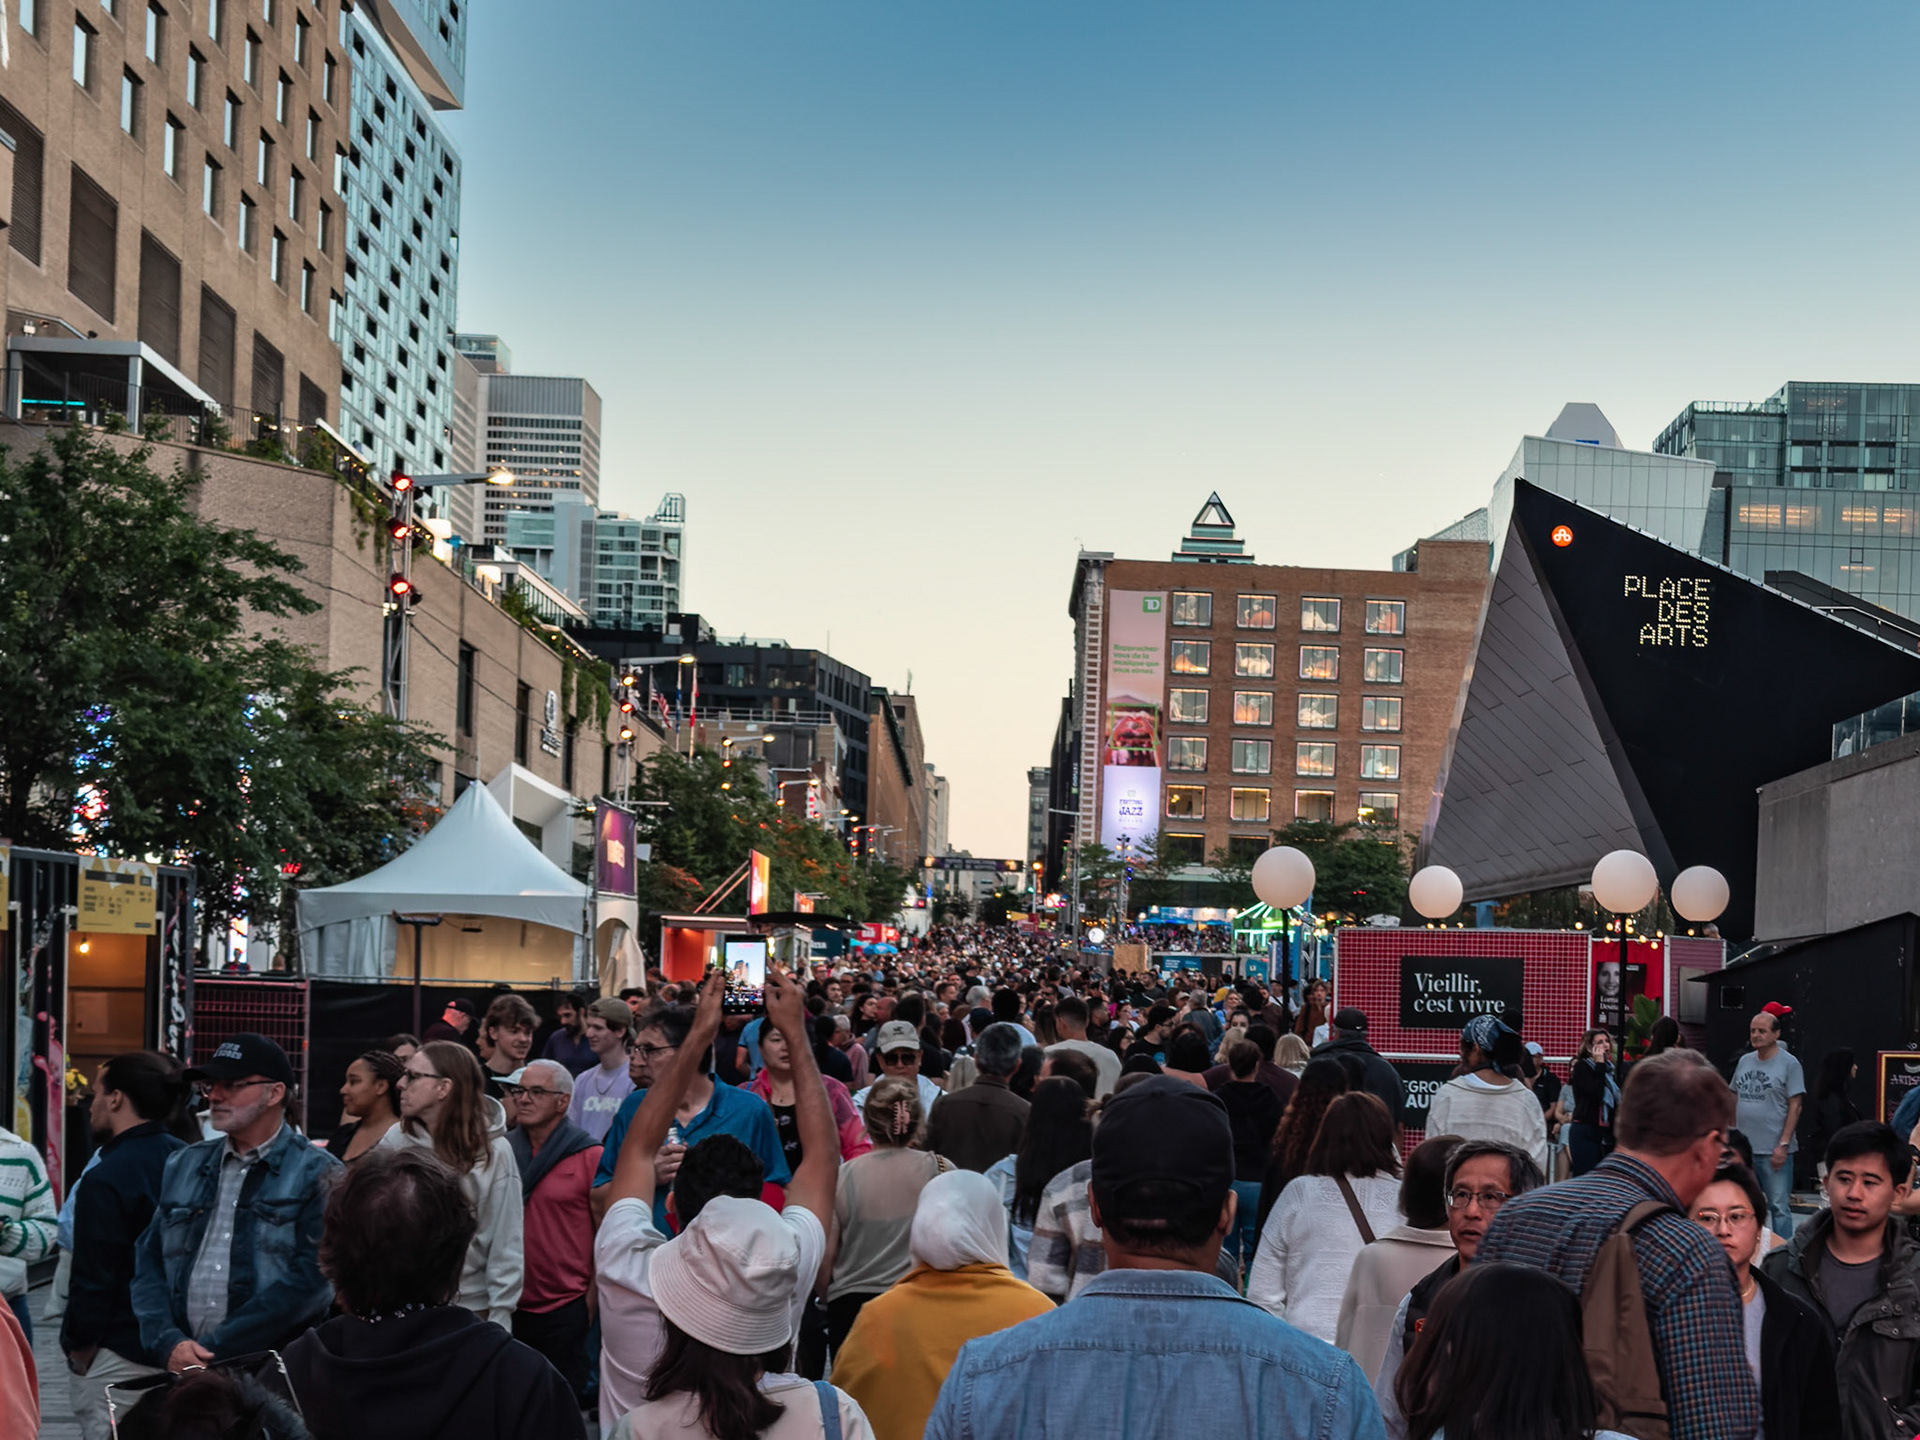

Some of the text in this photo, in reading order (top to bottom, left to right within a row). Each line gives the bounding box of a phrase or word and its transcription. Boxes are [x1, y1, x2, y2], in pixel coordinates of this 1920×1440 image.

[1624, 575, 1711, 600] PLACE
[1144, 598, 1160, 611] TD
[1658, 600, 1709, 624] DES
[1639, 622, 1709, 647] ARTS
[1119, 806, 1143, 816] JAZZ
[1414, 973, 1482, 994] Vieillir,
[1413, 993, 1505, 1013] c'est vivre
